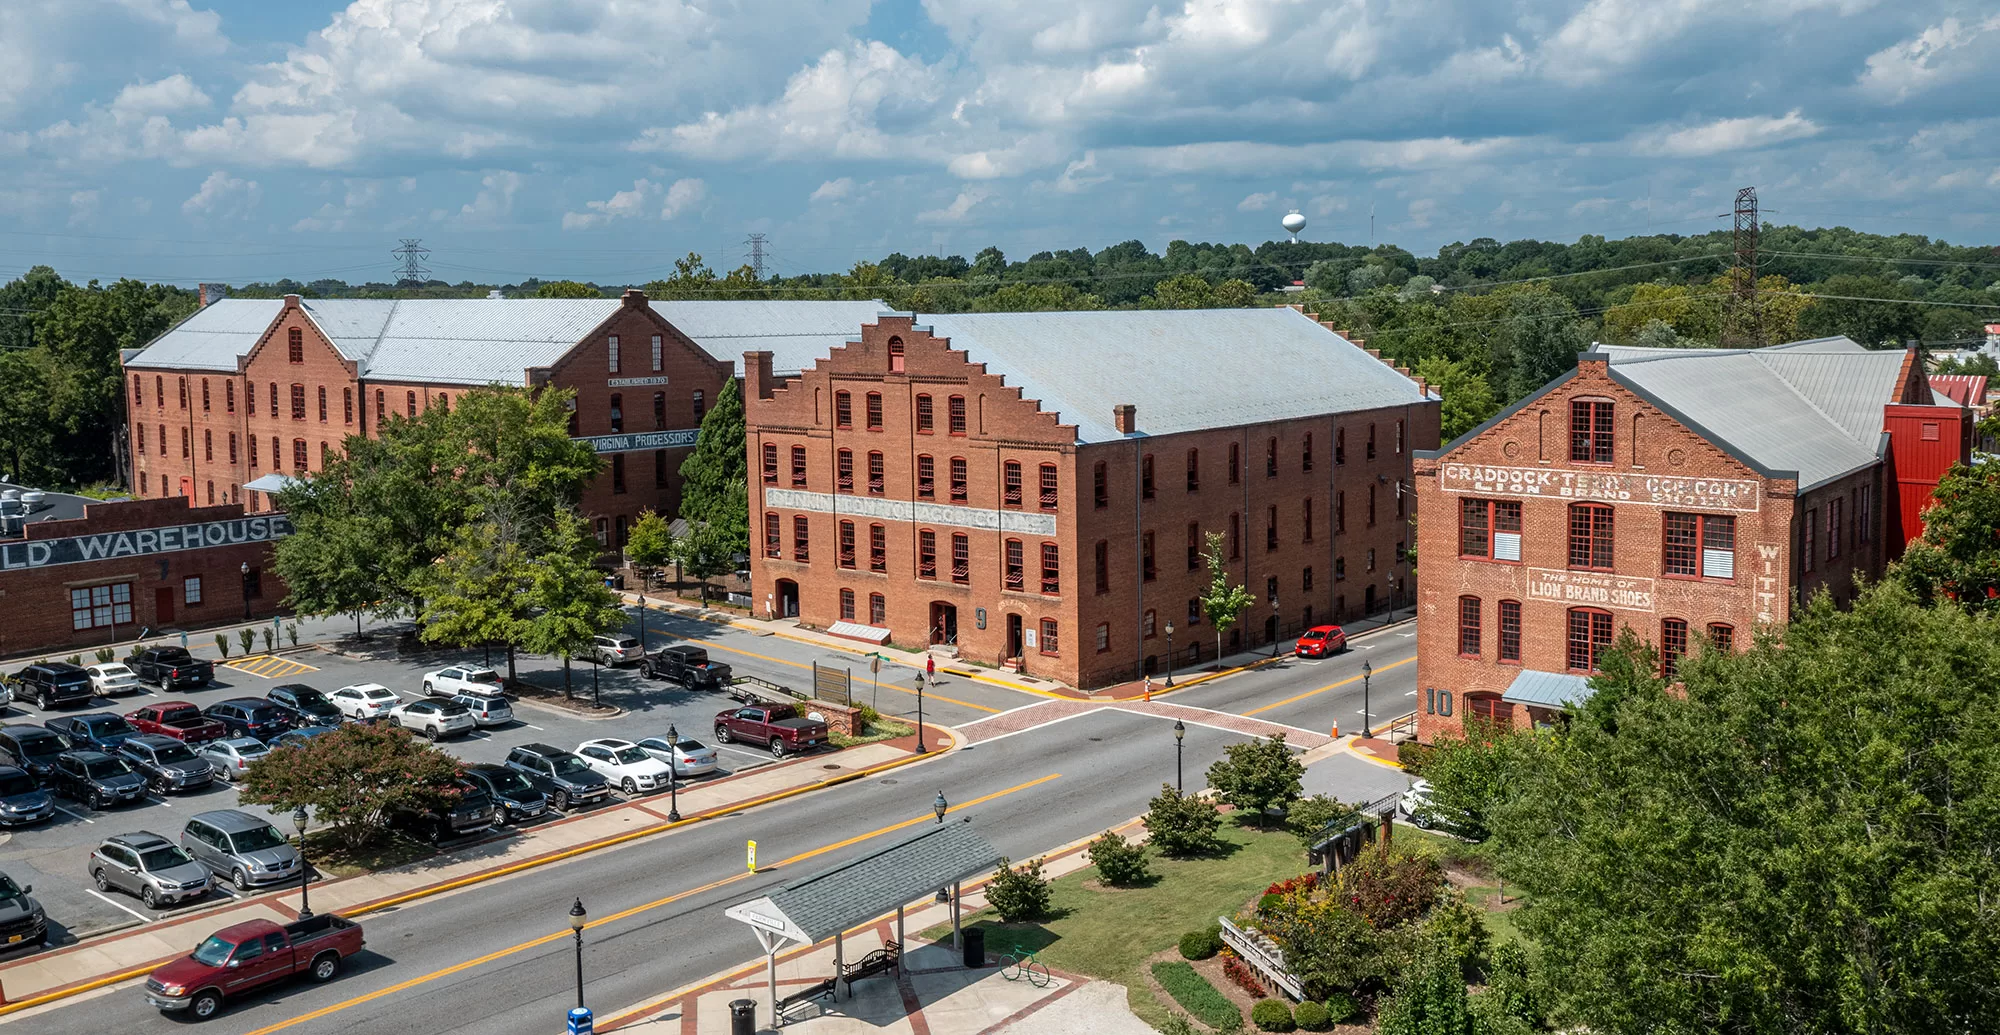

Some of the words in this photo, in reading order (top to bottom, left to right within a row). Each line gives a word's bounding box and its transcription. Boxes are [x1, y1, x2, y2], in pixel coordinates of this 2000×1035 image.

[592, 437, 629, 451] VIRGINIA
[635, 431, 694, 447] PROCESSORS
[1475, 482, 1540, 494] LION
[1560, 487, 1631, 500] BRAND
[76, 516, 289, 560] WAREHOUSE
[1542, 573, 1567, 582] THE
[1572, 576, 1610, 587] HOME
[1617, 580, 1637, 588] OF
[1531, 581, 1562, 598] LION
[1565, 585, 1609, 602] BRAND
[1610, 589, 1651, 607] SHOES
[975, 607, 987, 630] 9
[1427, 687, 1453, 717] 10
